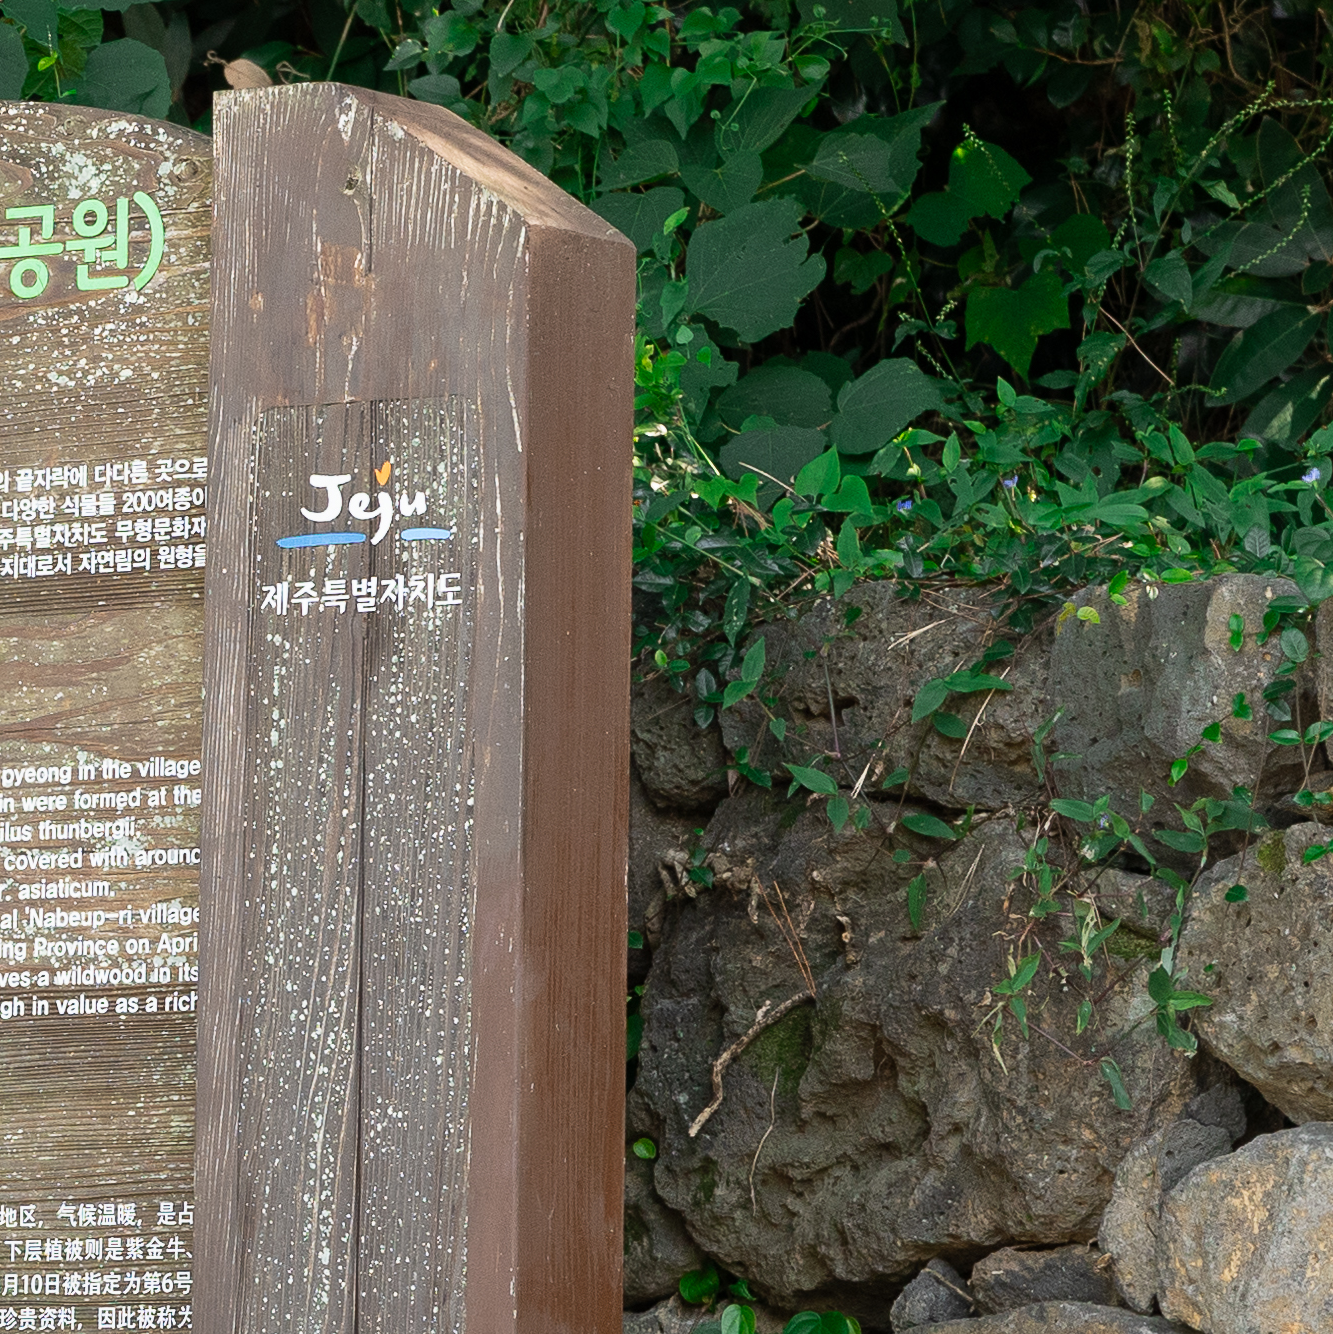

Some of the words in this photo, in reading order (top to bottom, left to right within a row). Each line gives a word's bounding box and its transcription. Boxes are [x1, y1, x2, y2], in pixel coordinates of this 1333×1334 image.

[15, 465, 88, 493] 끝자락에
[155, 457, 208, 483] 곳으로
[300, 461, 427, 546] Jeju
[261, 572, 463, 616] 제주특별자치도
[56, 993, 109, 1014] value
